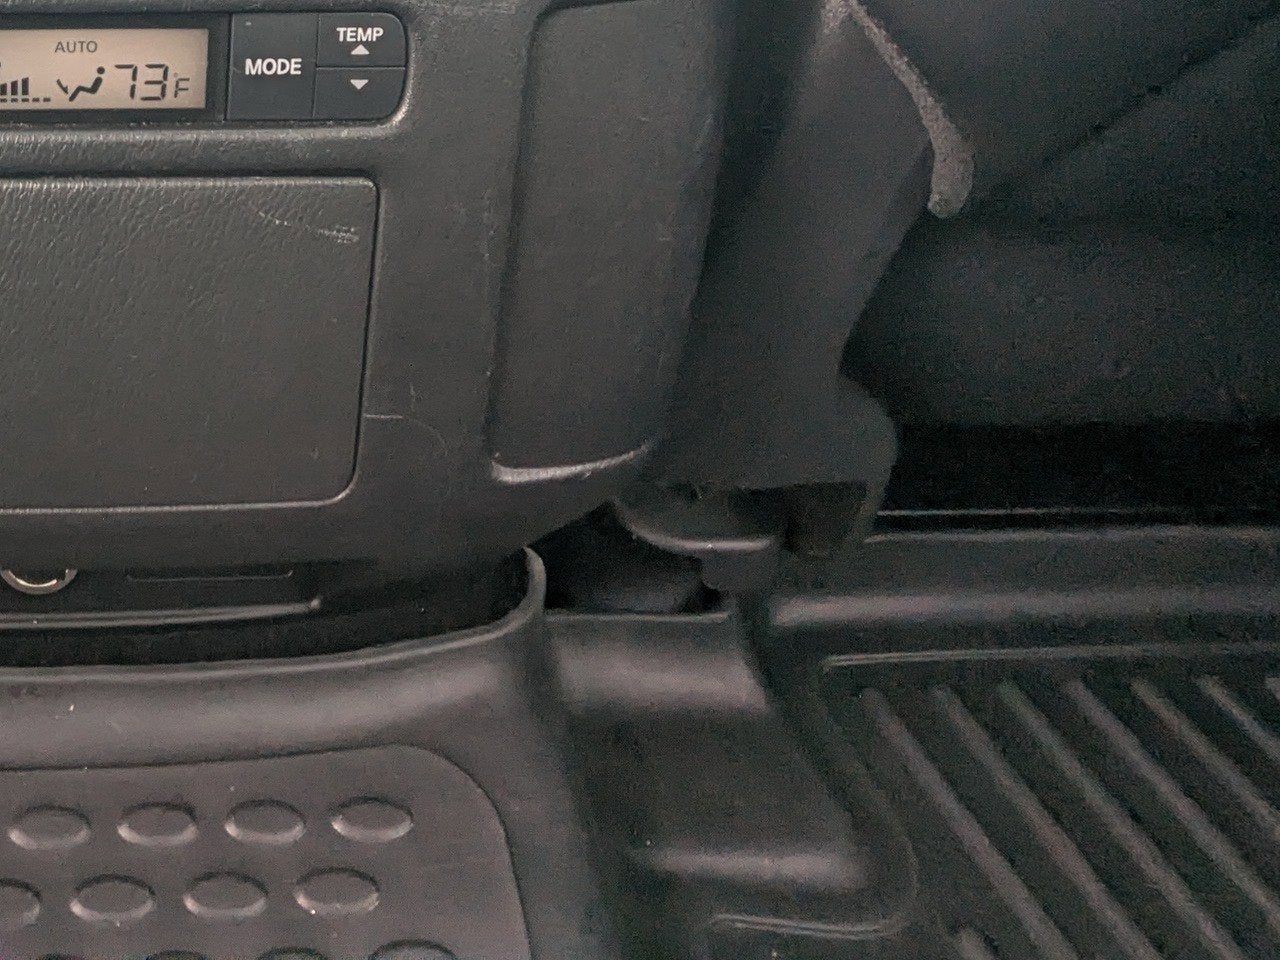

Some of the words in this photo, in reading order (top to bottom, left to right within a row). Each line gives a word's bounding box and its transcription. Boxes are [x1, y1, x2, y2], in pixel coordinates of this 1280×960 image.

[336, 27, 384, 42] TEMP
[54, 41, 98, 53] AUTO
[245, 58, 302, 75] MODE
